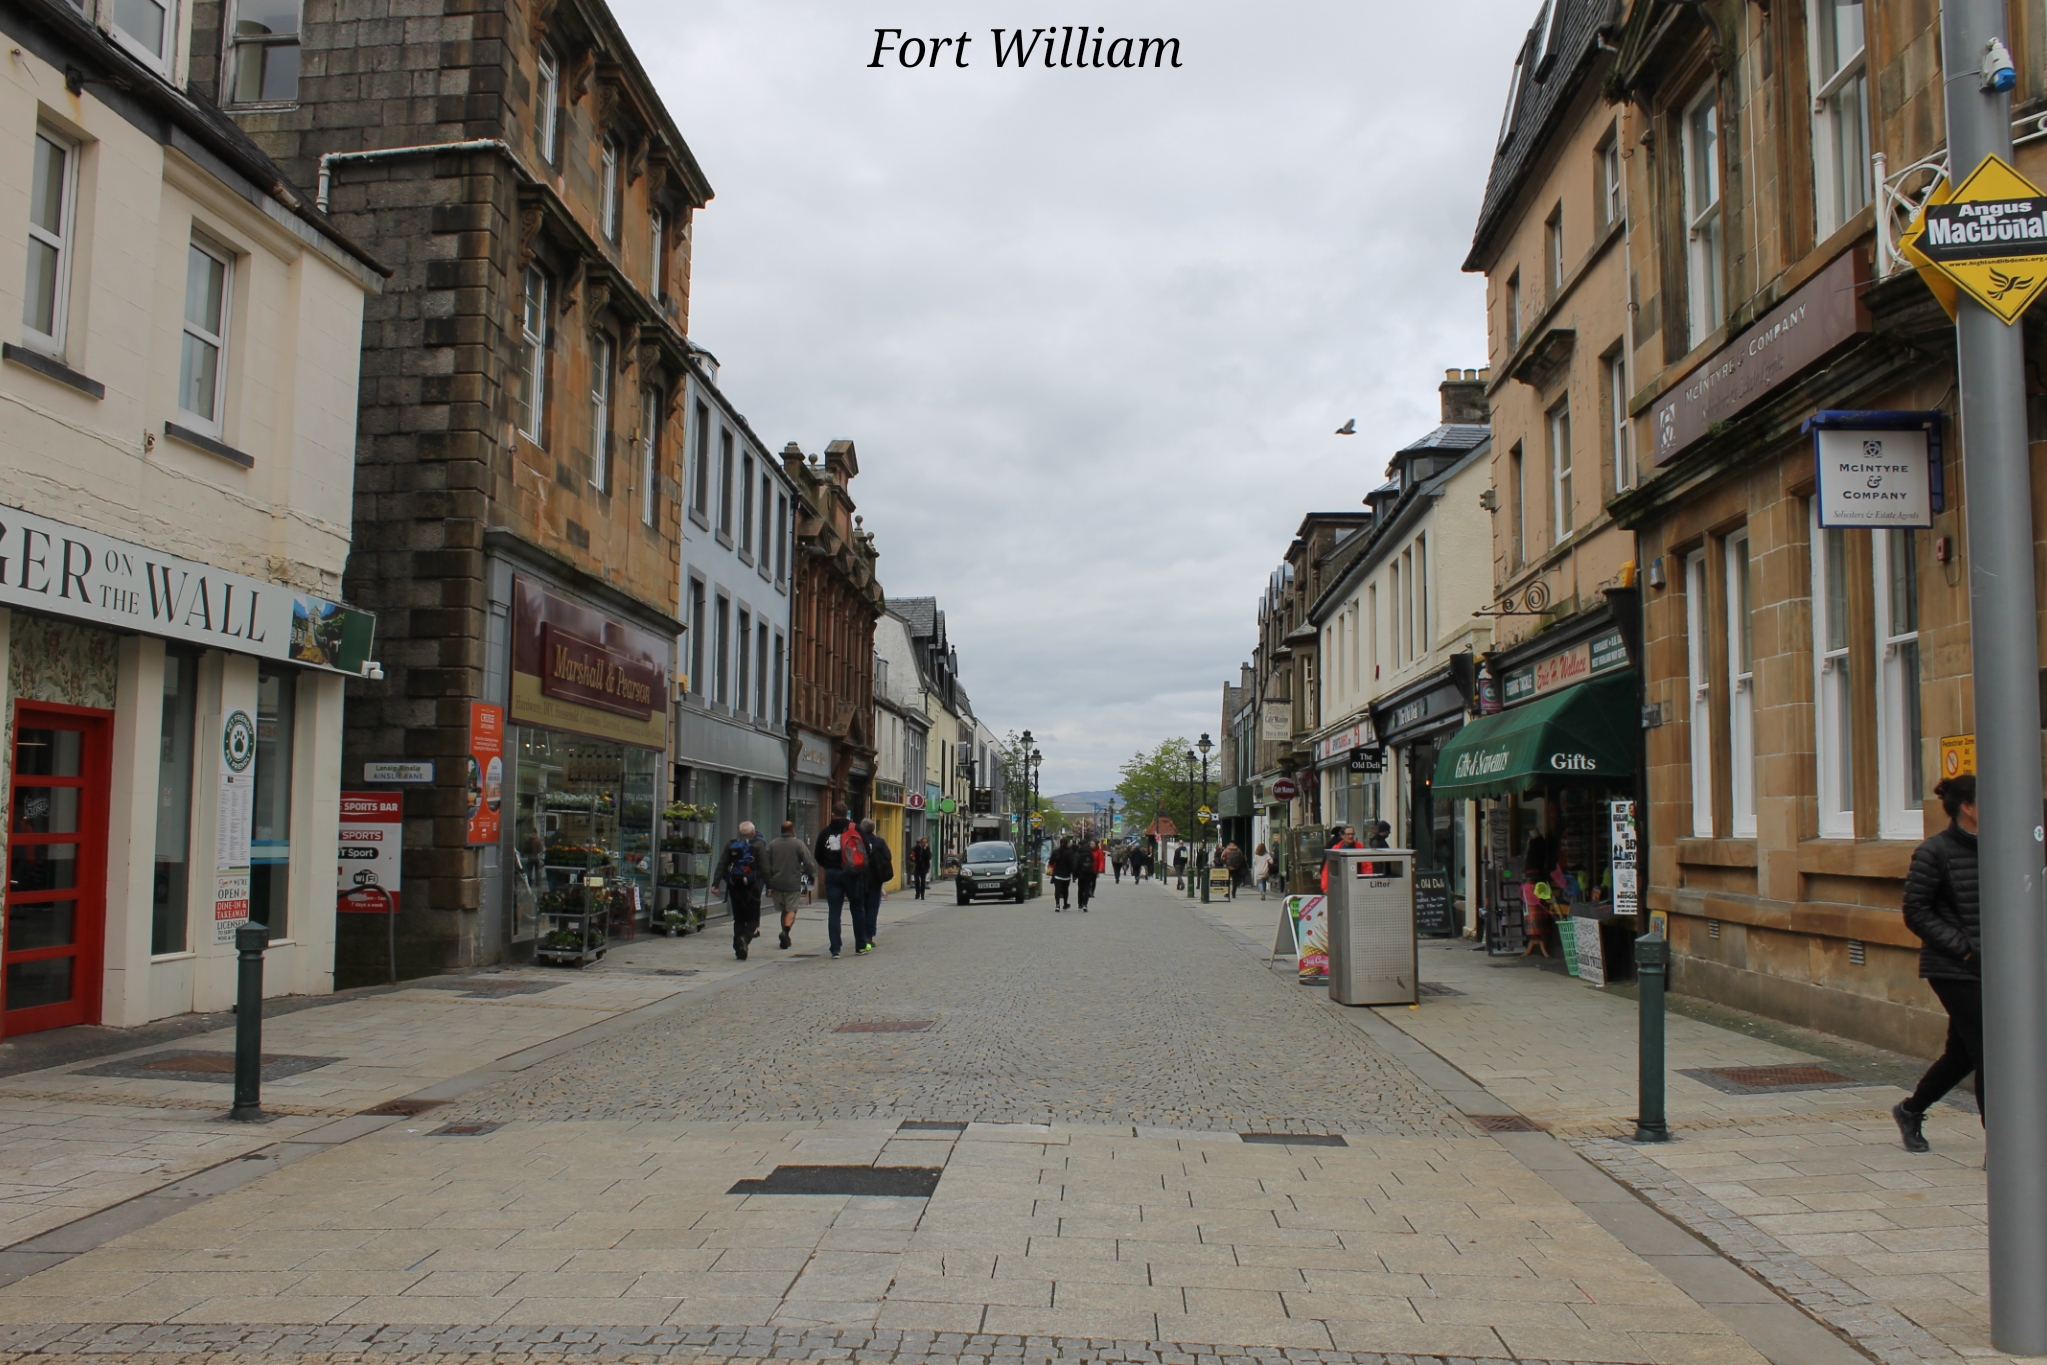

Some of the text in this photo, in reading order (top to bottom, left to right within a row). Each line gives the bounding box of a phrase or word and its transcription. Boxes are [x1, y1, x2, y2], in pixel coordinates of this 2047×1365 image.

[1958, 201, 2033, 218] Angus
[1748, 302, 1806, 357] COMPANY
[1866, 475, 1882, 489] &
[1842, 490, 1907, 500] COMPANY
[1833, 509, 1919, 521] Solicitors & Estate Agents
[0, 521, 266, 643] ER ON THE WALL
[554, 644, 650, 704] Marshall & Pearson
[1537, 664, 1549, 690] Eric
[1560, 651, 1586, 680] Wallace
[226, 718, 235, 733] PET
[234, 713, 253, 734] FRIENDLY
[1942, 737, 1975, 748] Pedestrian Zone
[231, 752, 251, 770] FRIENDLY
[1359, 752, 1373, 760] The
[1551, 752, 1596, 770] Gifts
[1351, 761, 1380, 769] Old Deli
[373, 772, 423, 780] AINSLIE LANE
[344, 802, 378, 811] SPORTS
[379, 803, 399, 812] BAR
[342, 831, 382, 840] SPORTS
[348, 848, 374, 858] Sport
[1370, 881, 1391, 889] Litter
[1420, 879, 1431, 889] Old
[217, 889, 240, 900] OPEN
[217, 900, 248, 911] DINE-IN &
[216, 910, 248, 920] TAKEAWAY
